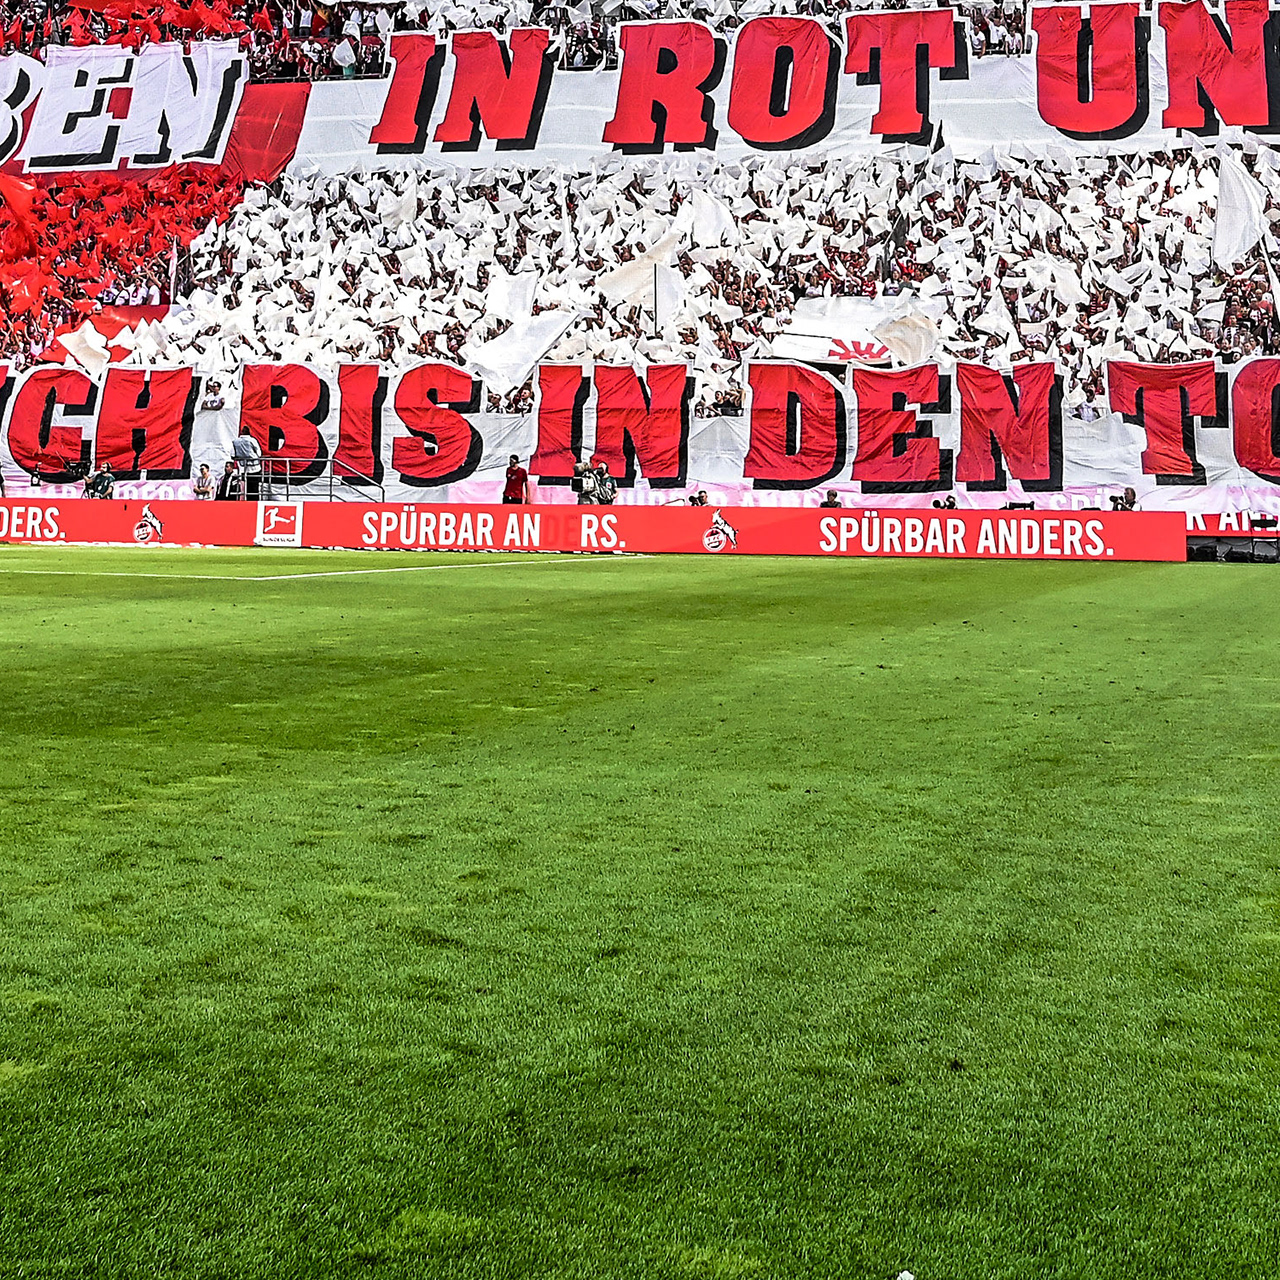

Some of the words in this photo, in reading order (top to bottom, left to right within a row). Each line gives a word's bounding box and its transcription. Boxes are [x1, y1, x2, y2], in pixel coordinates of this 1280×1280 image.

[370, 28, 557, 154] IN
[602, 9, 969, 155] ROT
[240, 362, 482, 487] BIS
[529, 364, 695, 488] IN
[745, 361, 1063, 494] DEN
[362, 505, 493, 547] SPÜRBAR
[820, 510, 965, 554] SPÜRBAR
[977, 519, 1115, 556] ANDERS.
